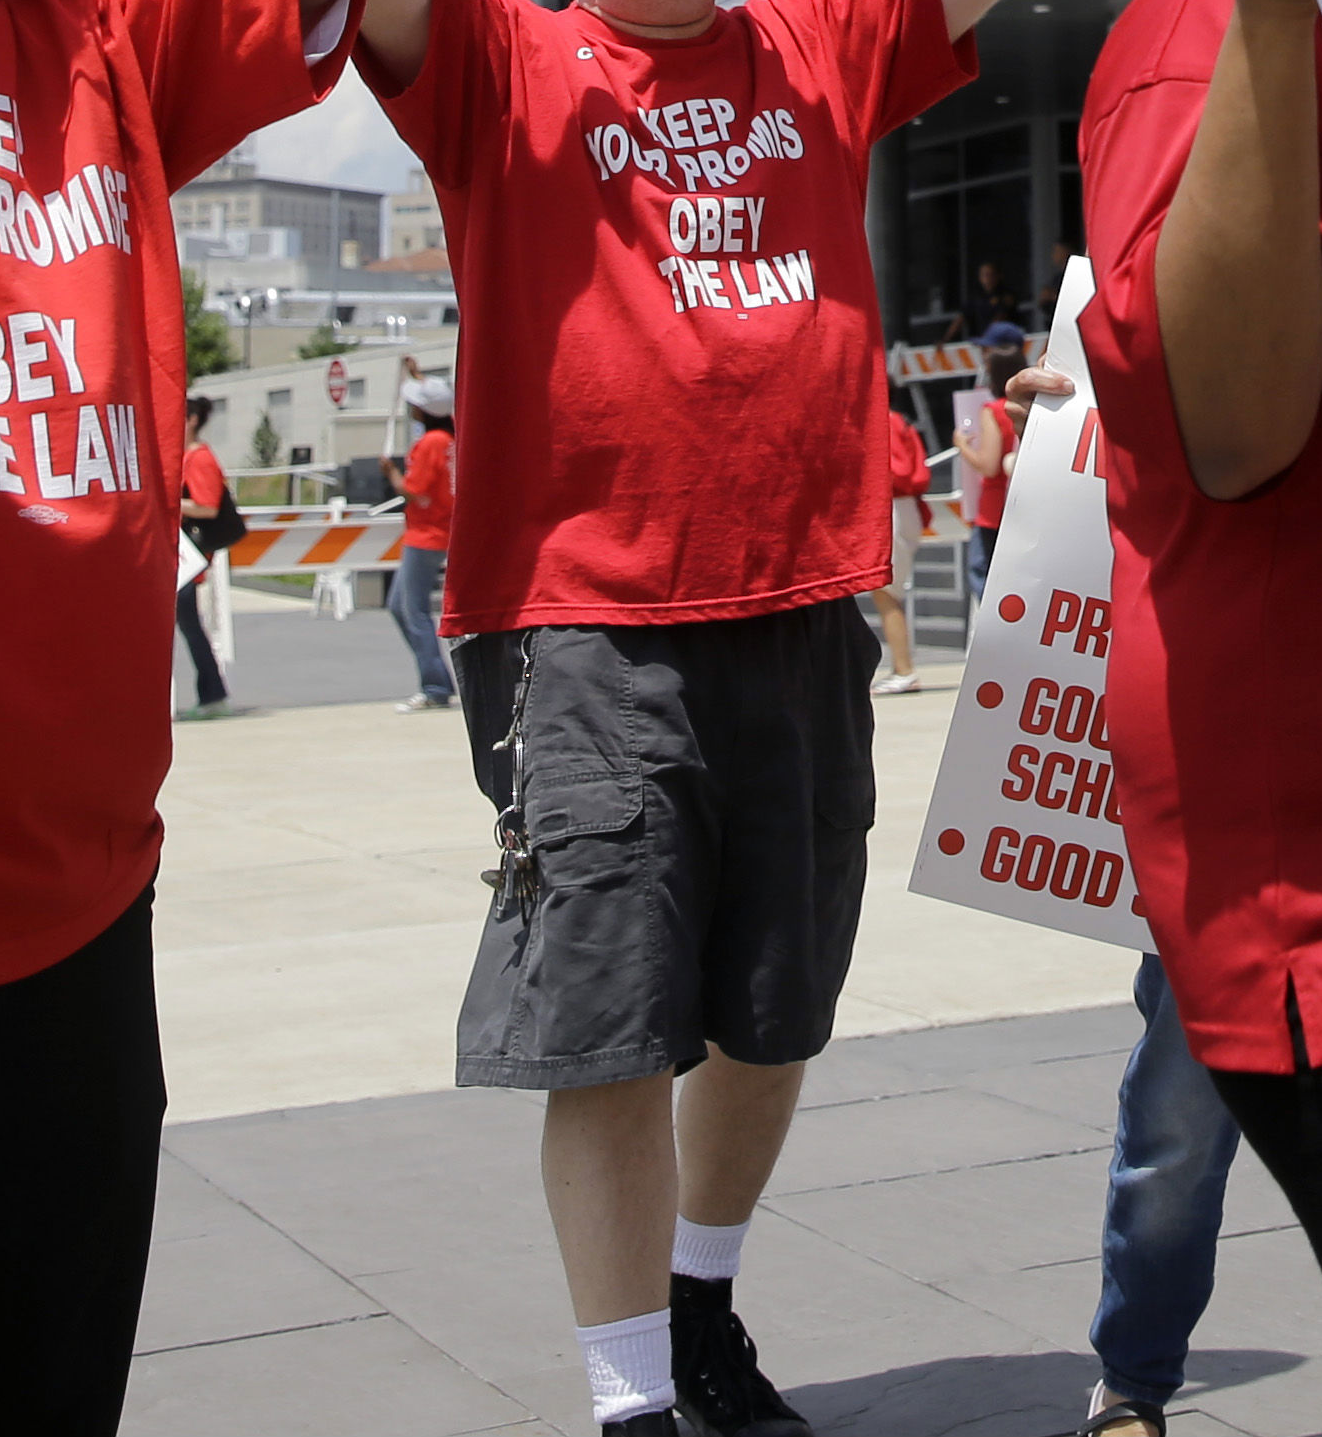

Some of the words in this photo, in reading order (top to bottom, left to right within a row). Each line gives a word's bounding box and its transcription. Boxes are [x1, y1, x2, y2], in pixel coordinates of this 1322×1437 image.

[637, 97, 736, 150] KEEP
[668, 196, 765, 254] OBEY
[657, 256, 733, 314] THE
[729, 249, 816, 310] LAW
[30, 403, 143, 500] LAW
[980, 826, 1125, 909] GOOD
